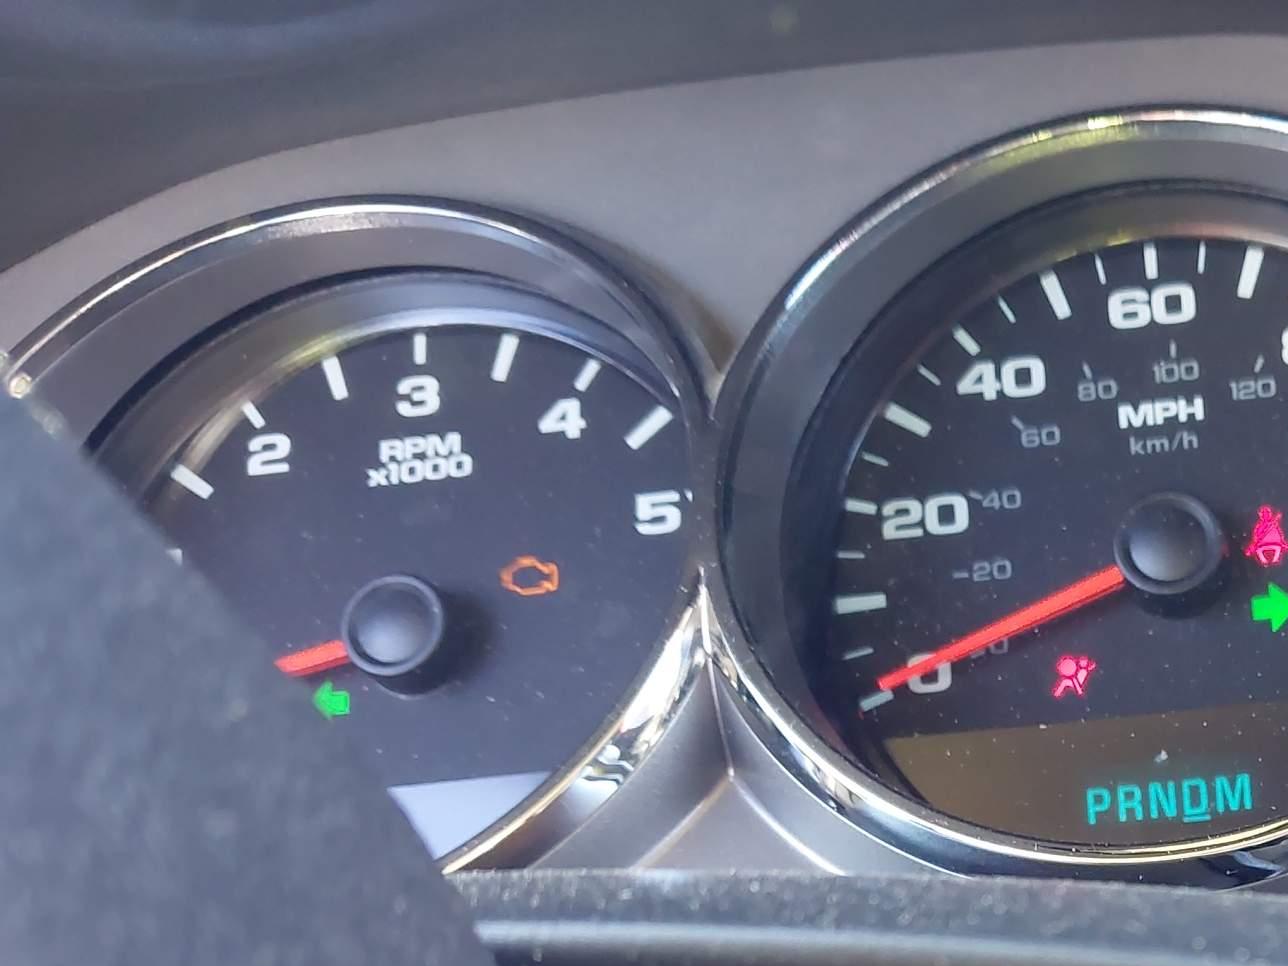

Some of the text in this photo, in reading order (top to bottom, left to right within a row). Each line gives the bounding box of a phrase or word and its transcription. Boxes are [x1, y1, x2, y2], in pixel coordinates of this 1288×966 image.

[1108, 282, 1196, 329] 60
[957, 356, 1046, 400] 40
[1153, 359, 1199, 383] 100
[396, 375, 440, 416] 3
[1077, 379, 1118, 401] 80
[1230, 376, 1276, 400] 120
[538, 399, 586, 439] 4
[1118, 397, 1204, 429] MPH
[378, 433, 461, 463] RPM
[1021, 425, 1060, 448] 60
[1131, 431, 1198, 455] km/h
[247, 433, 291, 476] 2
[367, 454, 472, 486] x1000
[634, 491, 681, 535] 5
[982, 489, 1021, 510] 40
[882, 493, 969, 540] 20
[972, 559, 1012, 582] 20
[1086, 772, 1252, 824] PRNDM
